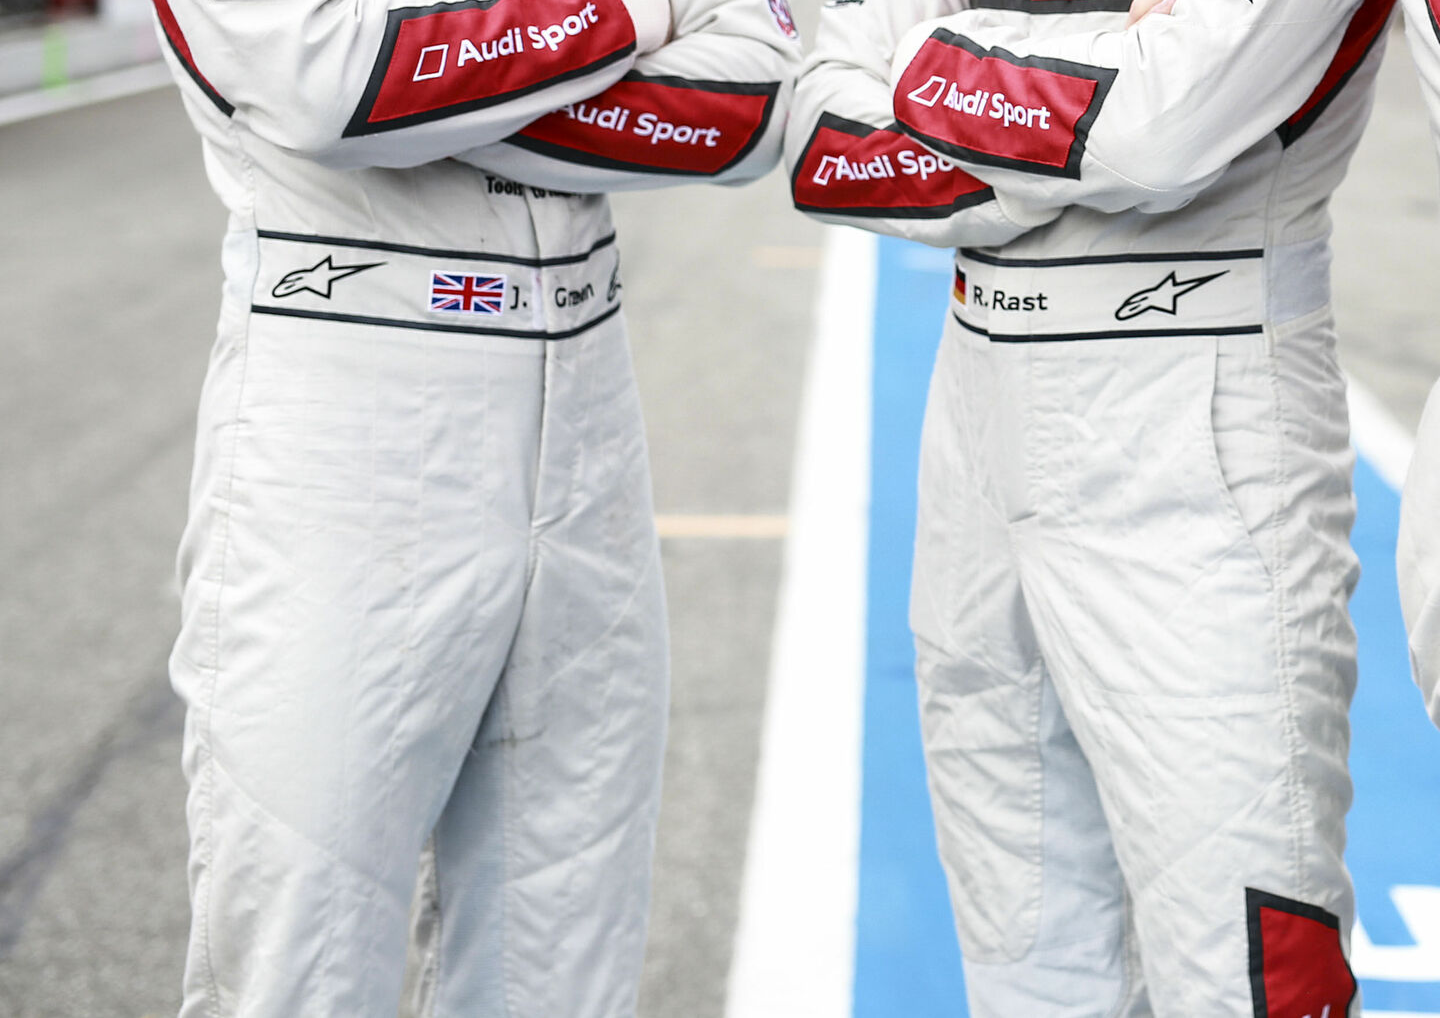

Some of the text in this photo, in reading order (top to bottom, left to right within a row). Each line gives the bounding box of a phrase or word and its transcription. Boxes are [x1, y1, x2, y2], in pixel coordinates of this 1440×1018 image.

[457, 2, 599, 67] Audi Sport
[943, 81, 1051, 130] Audi Sport
[633, 112, 721, 147] Sport
[835, 149, 955, 181] Audi Spo
[510, 286, 528, 310] J.
[973, 285, 1048, 312] R. Rast
